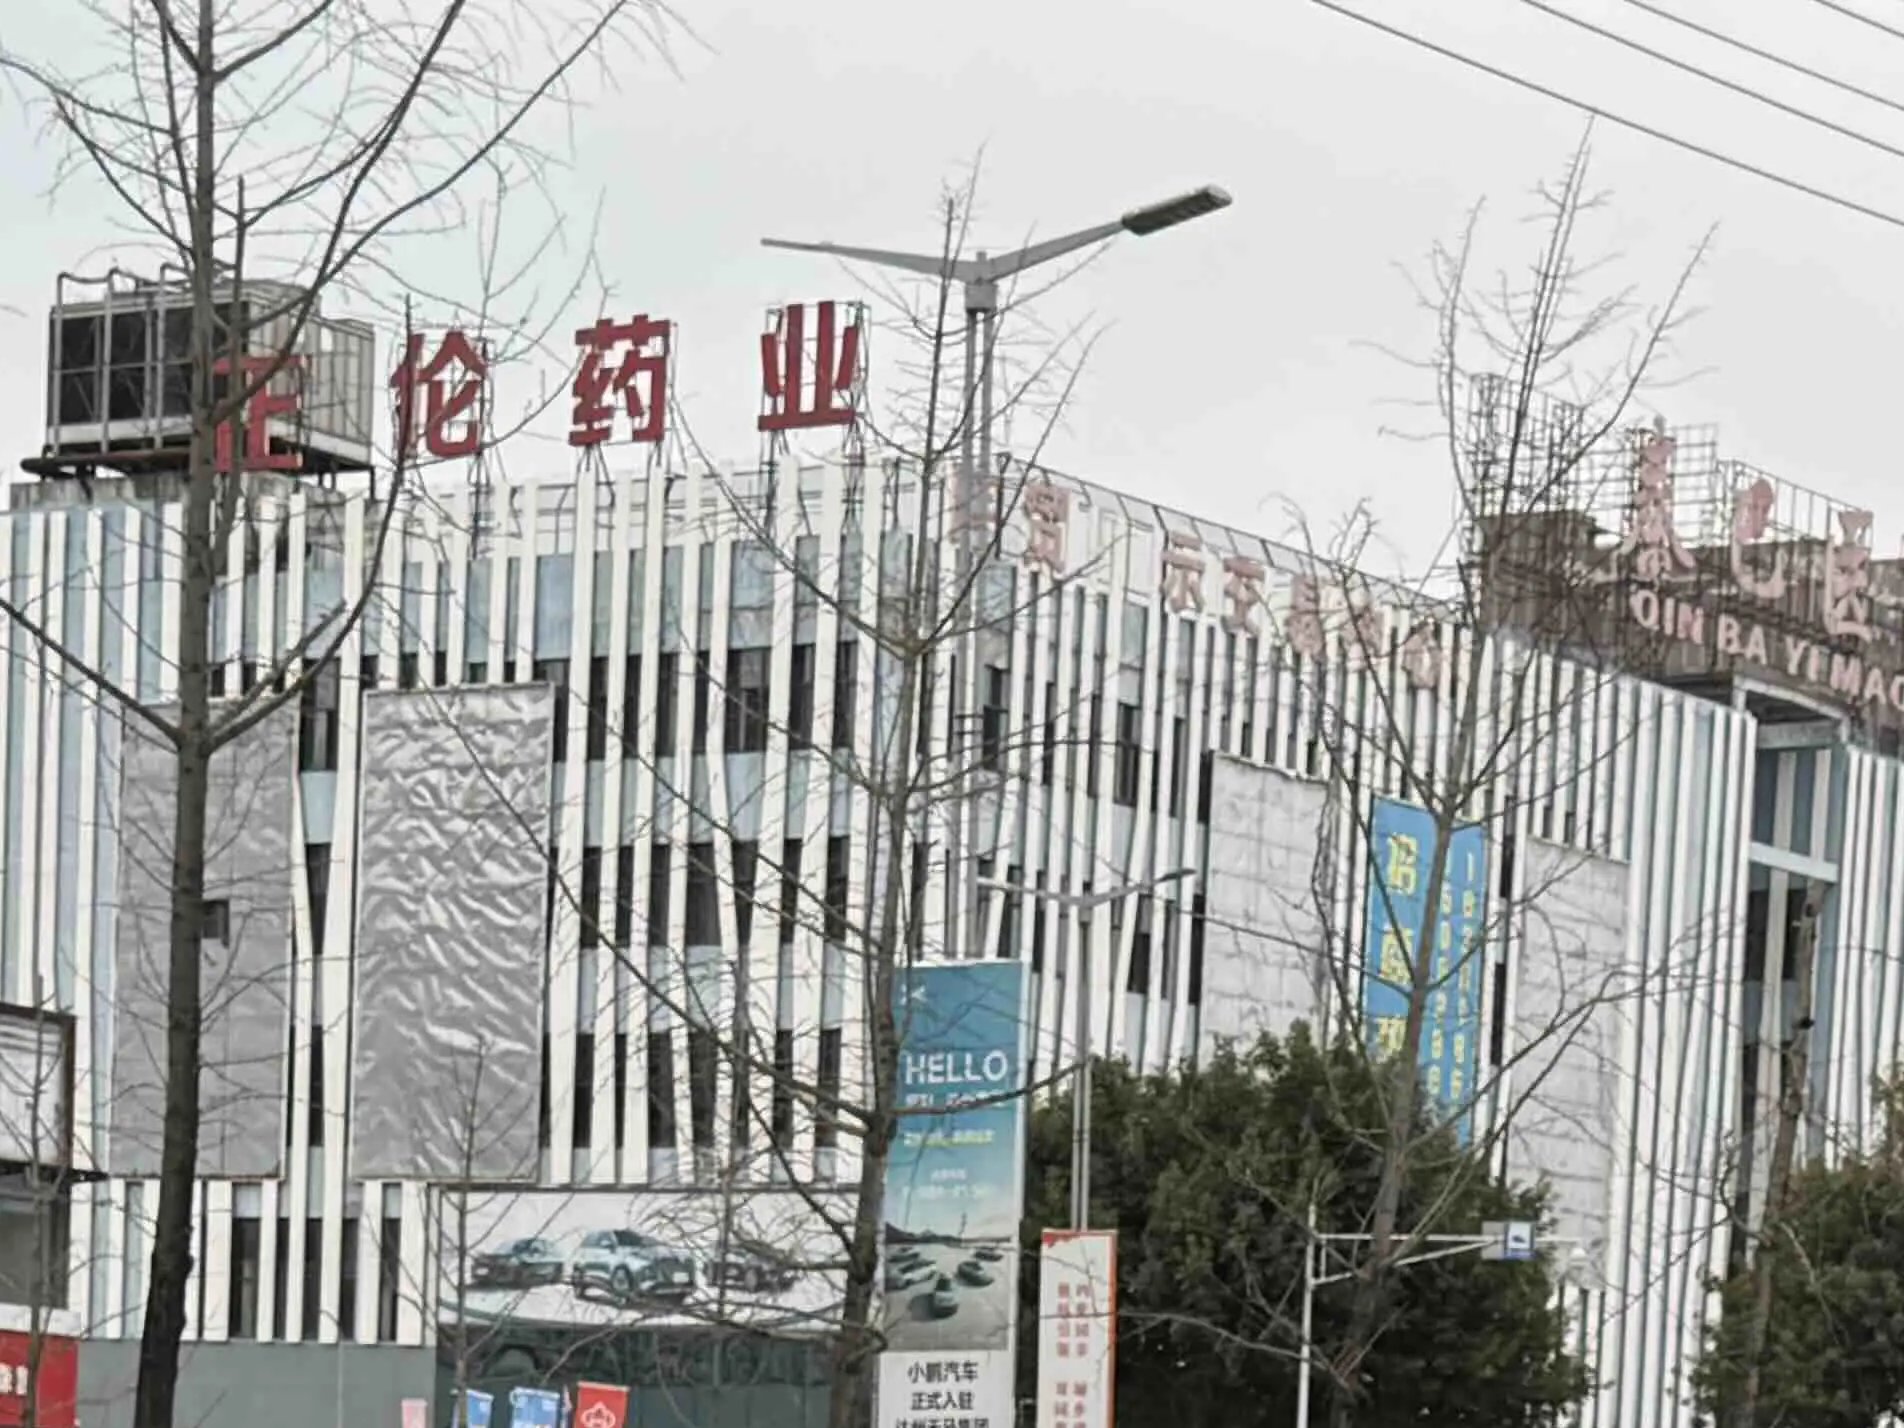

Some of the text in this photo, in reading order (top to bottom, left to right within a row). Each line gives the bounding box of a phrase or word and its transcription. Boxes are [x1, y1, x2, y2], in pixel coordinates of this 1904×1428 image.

[213, 300, 859, 473] 正伦药业
[1629, 589, 1704, 645] QIN
[1717, 614, 1768, 666] BA
[904, 1050, 1009, 1086] HELLO
[907, 1360, 979, 1384] 小鹏汽车
[911, 1391, 974, 1411] 正式入驻
